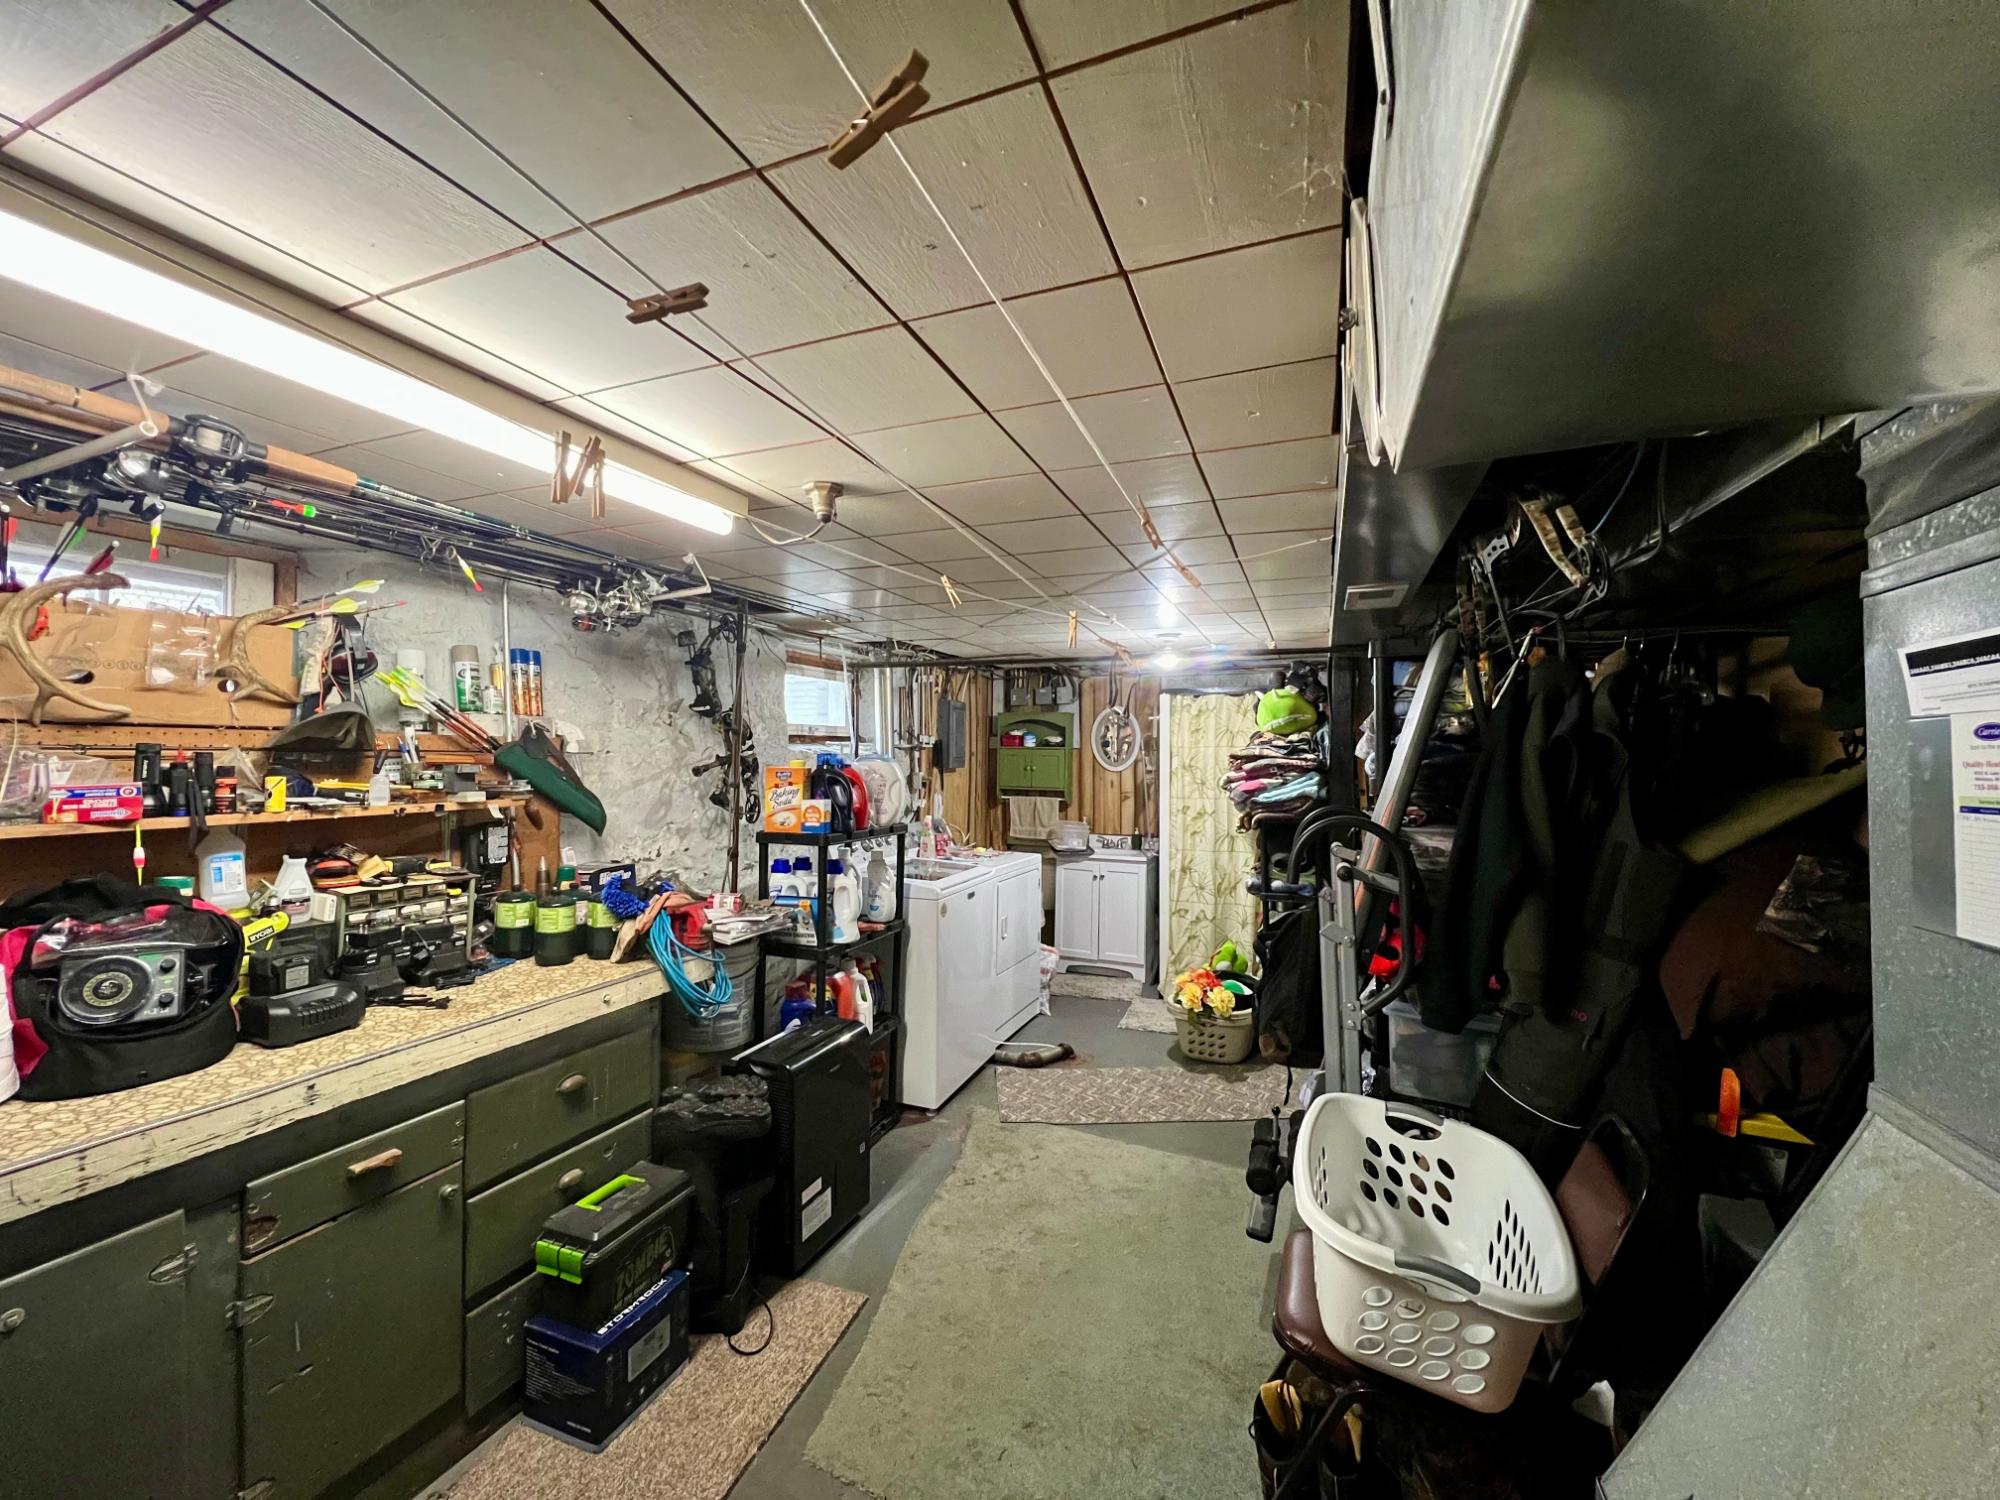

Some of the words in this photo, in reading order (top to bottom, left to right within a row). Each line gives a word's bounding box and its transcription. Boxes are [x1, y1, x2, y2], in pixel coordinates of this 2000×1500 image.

[769, 787, 800, 801] Baking
[772, 798, 792, 809] Soda
[249, 927, 274, 942] RYOBI
[616, 1231, 670, 1299] ZOMBIE
